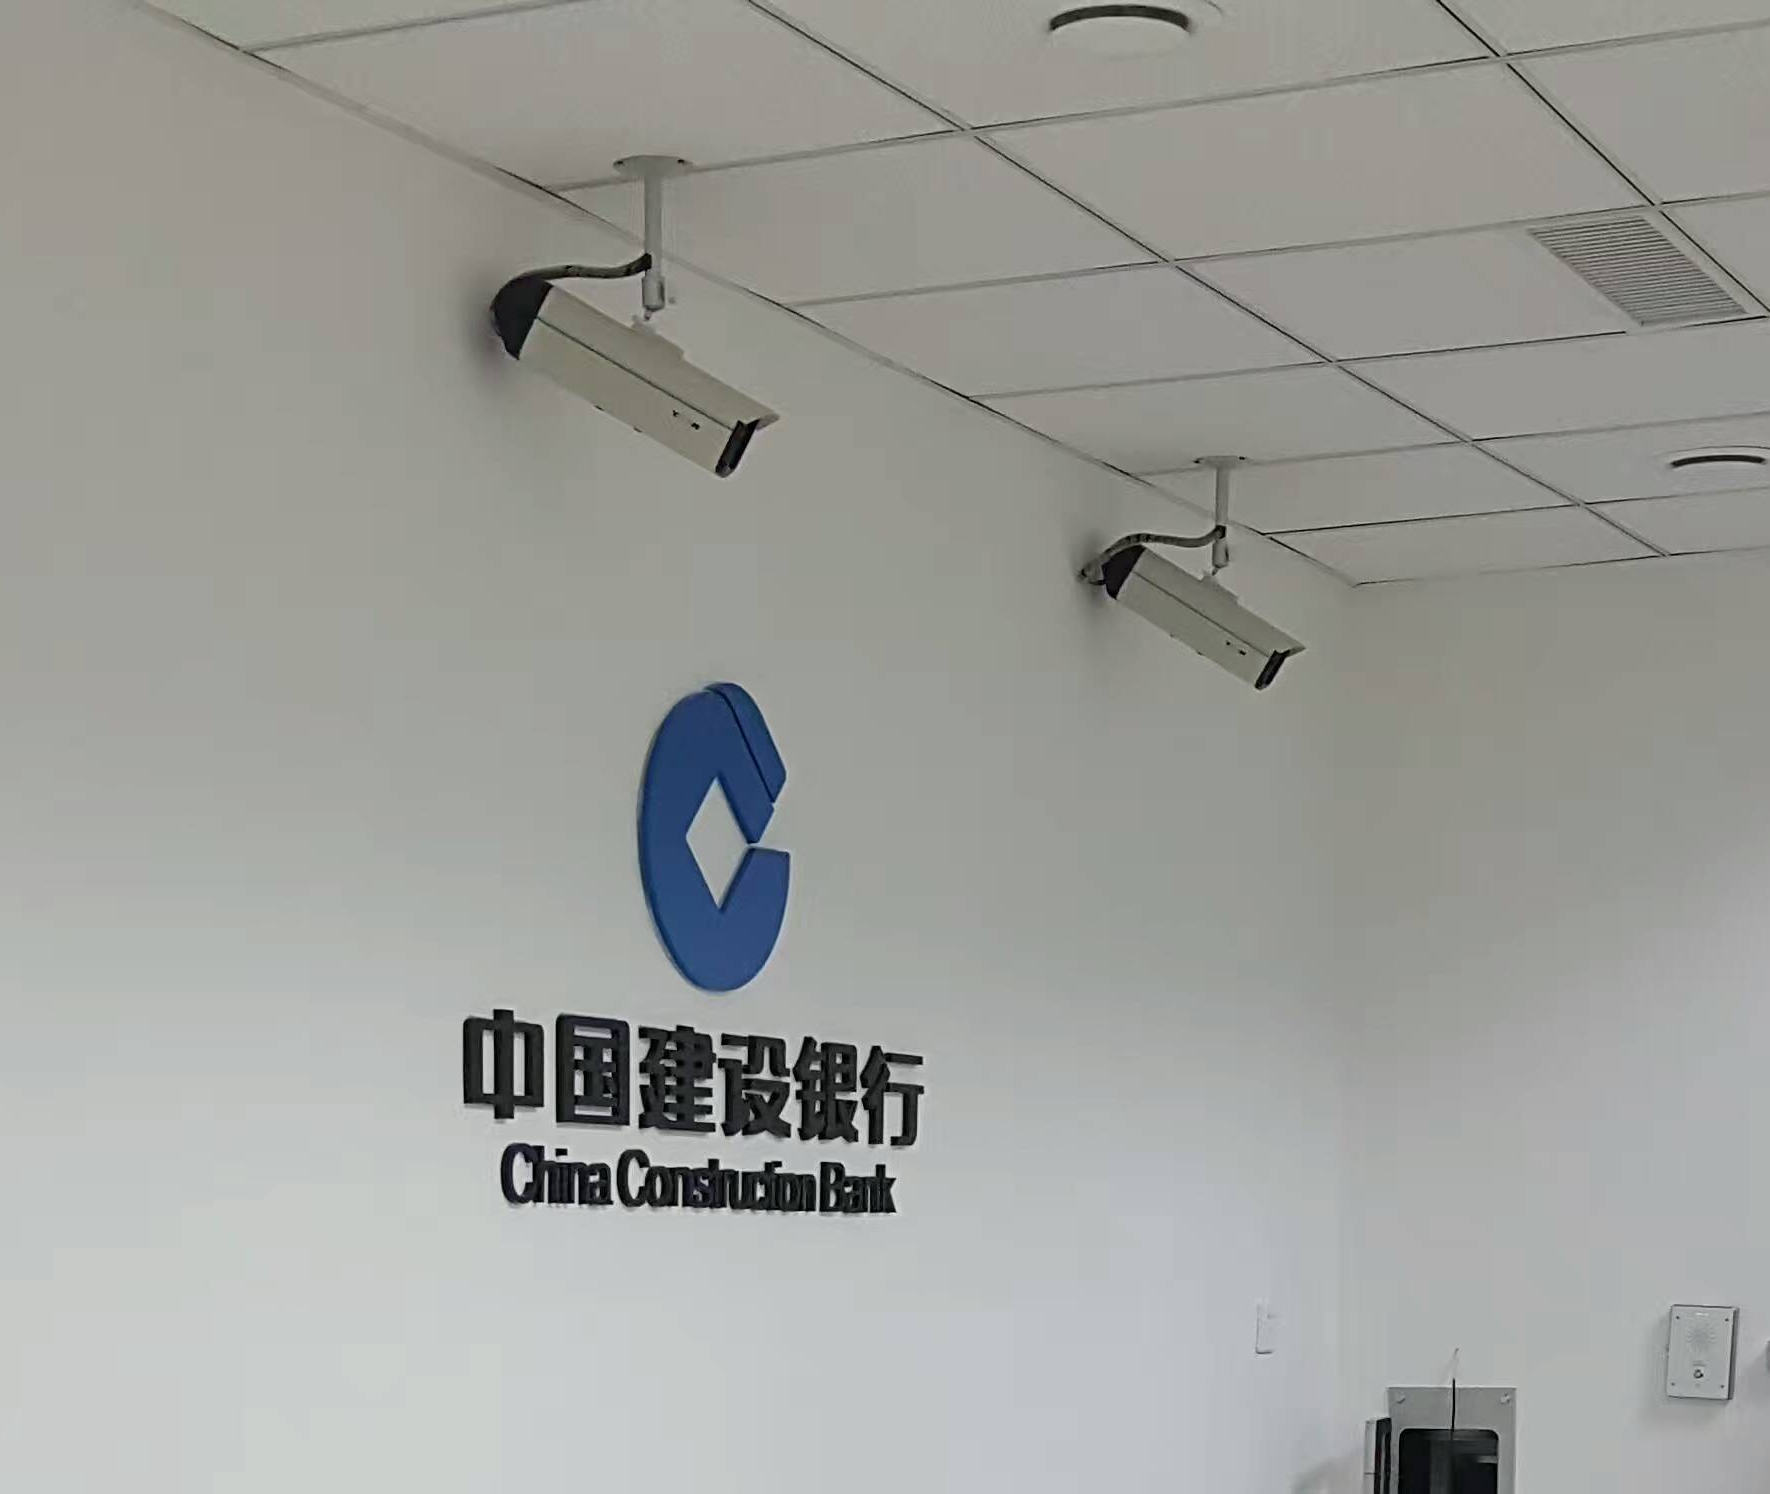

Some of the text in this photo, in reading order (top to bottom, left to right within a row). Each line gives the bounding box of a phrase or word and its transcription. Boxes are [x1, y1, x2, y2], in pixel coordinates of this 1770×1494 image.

[462, 1009, 925, 1146] 中国建设银行
[501, 1142, 897, 1214] China Construction Bank
